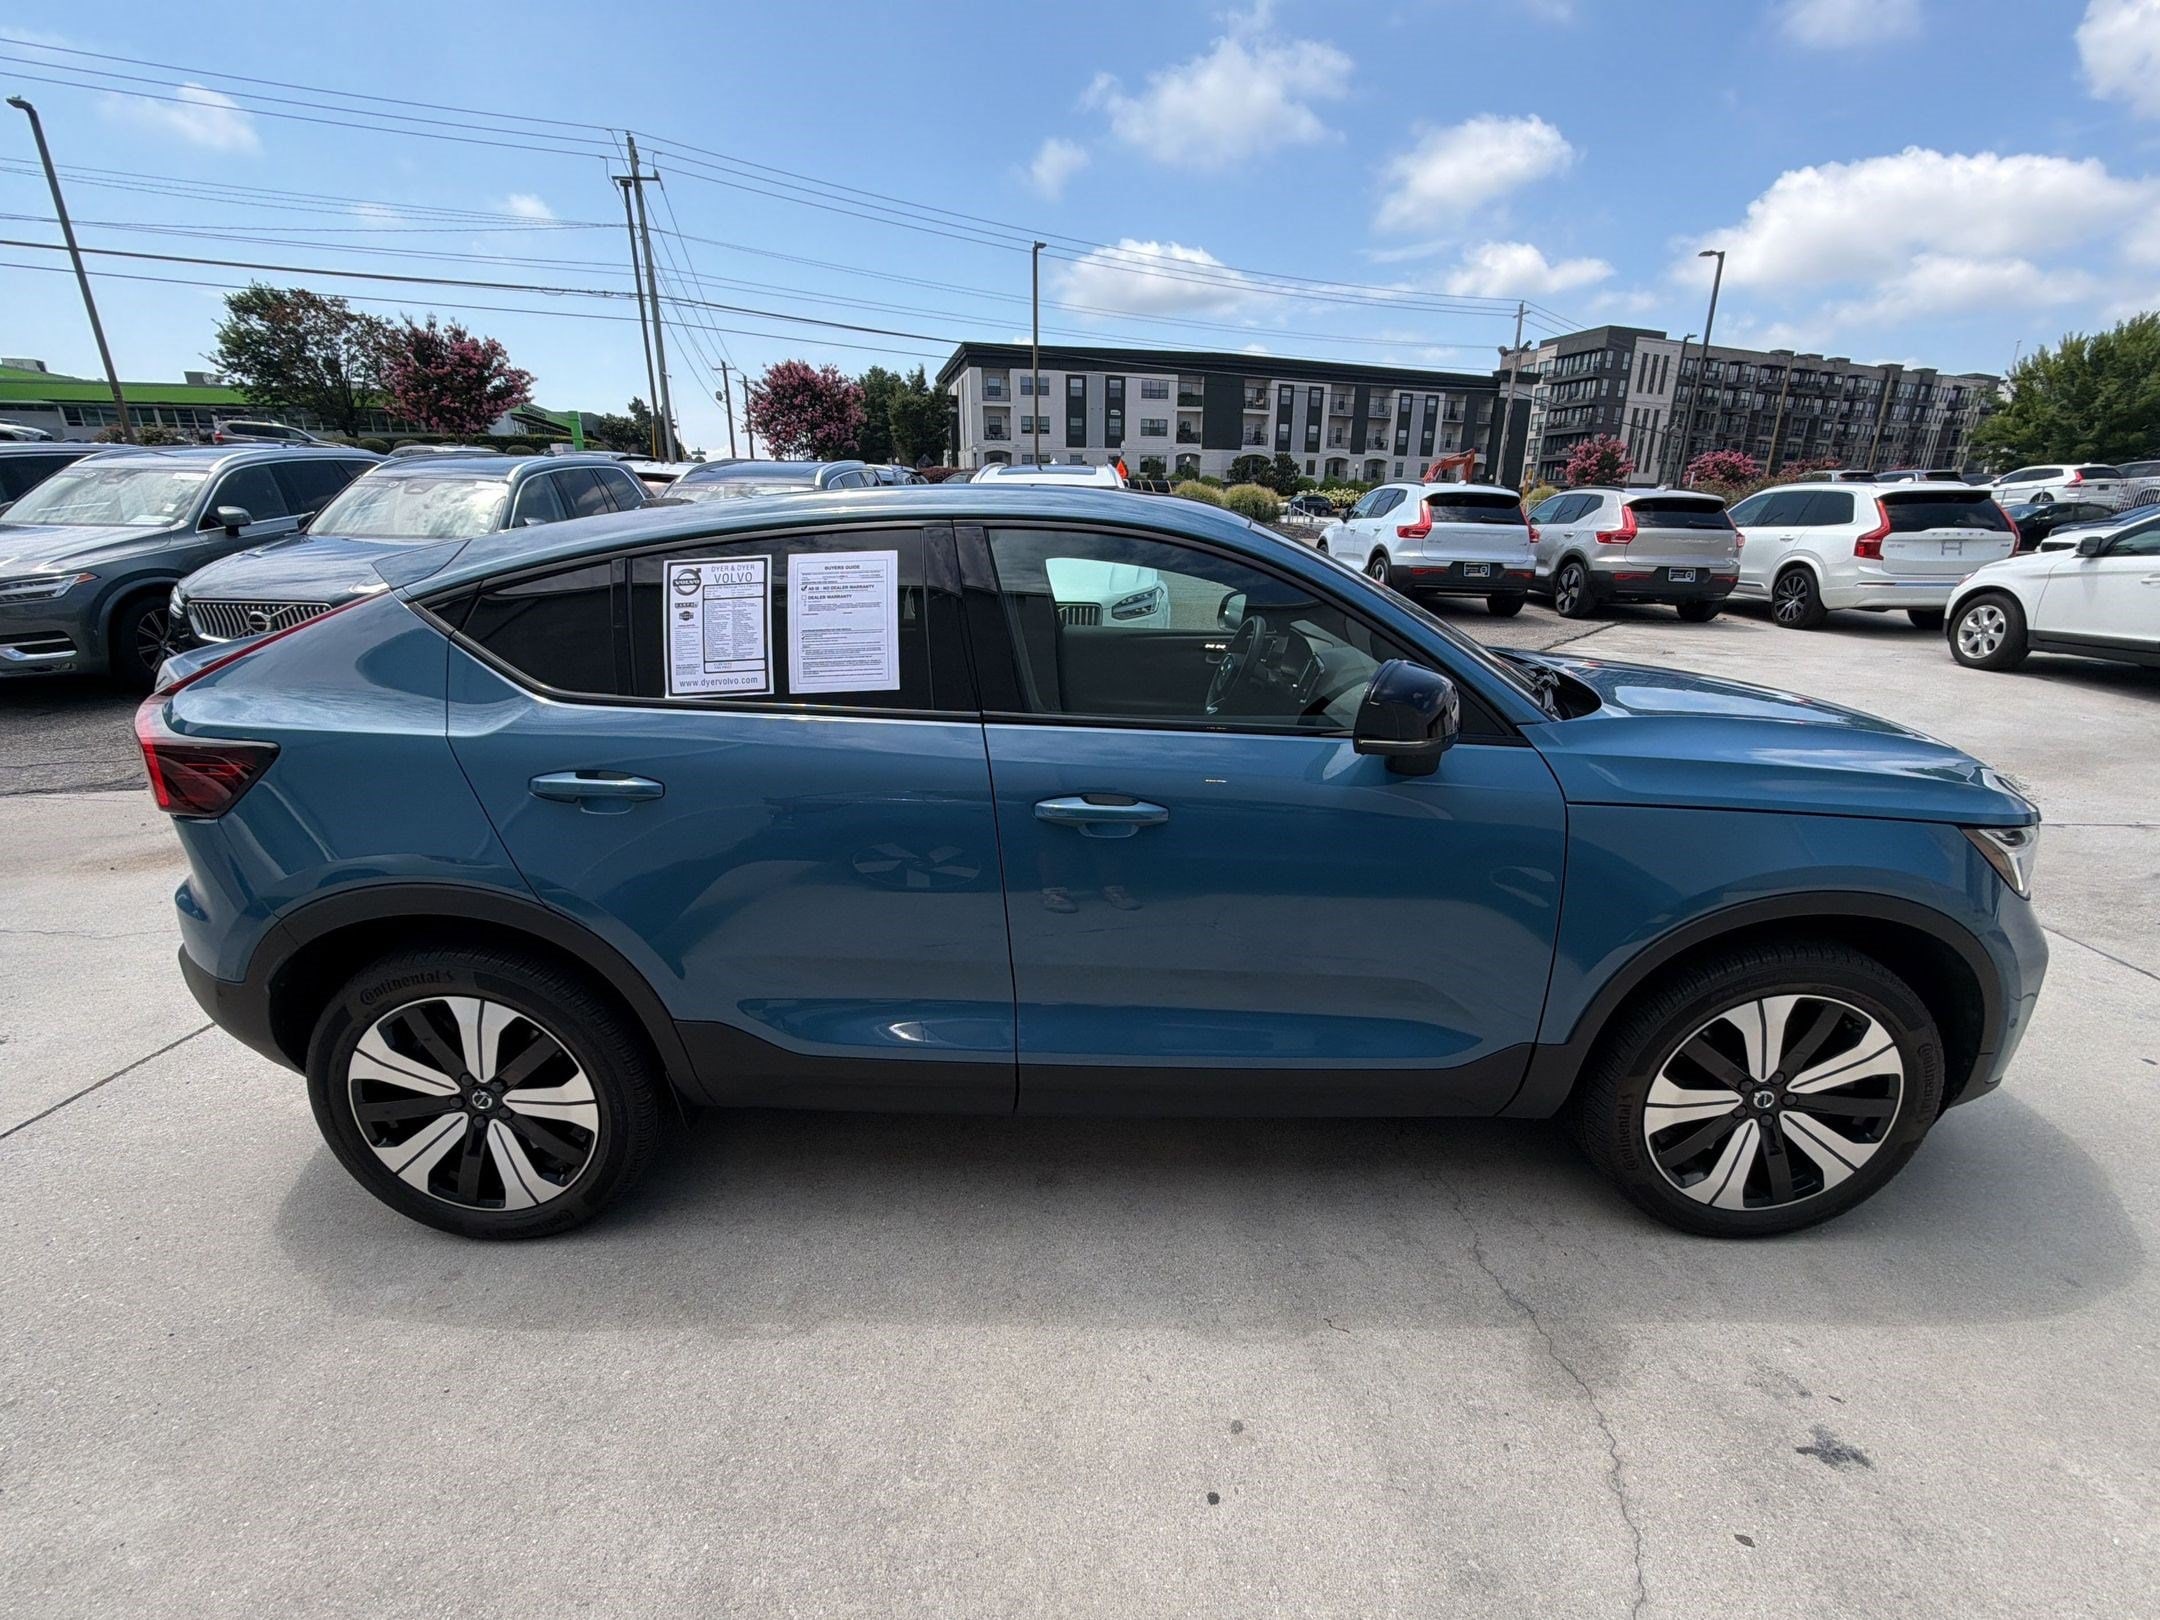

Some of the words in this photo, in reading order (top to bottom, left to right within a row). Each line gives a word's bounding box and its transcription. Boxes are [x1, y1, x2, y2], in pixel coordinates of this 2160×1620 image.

[714, 572, 753, 584] VOLVO
[679, 676, 758, 688] www.dyervolvo.com
[360, 970, 440, 1005] Continental
